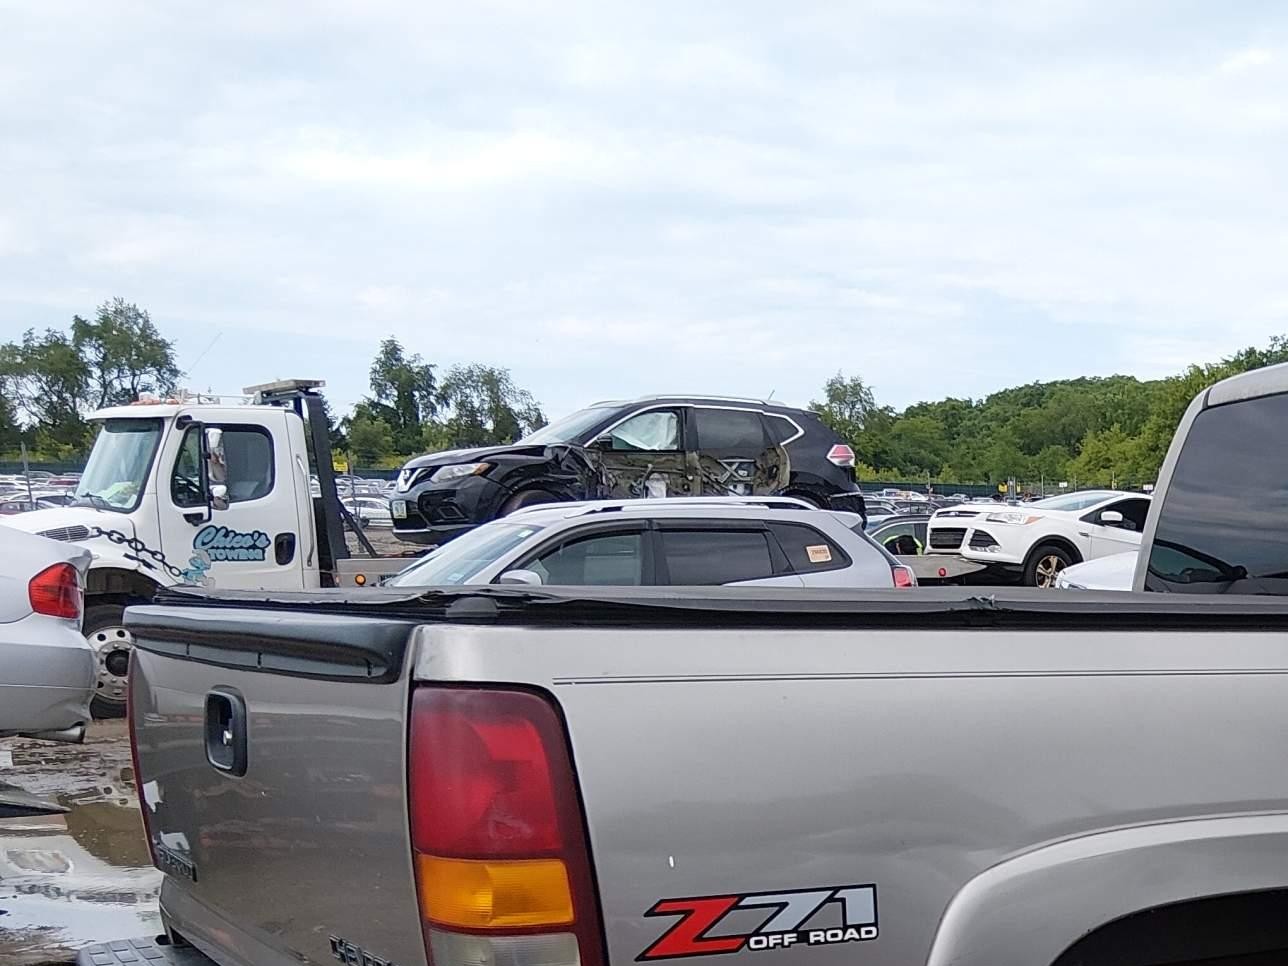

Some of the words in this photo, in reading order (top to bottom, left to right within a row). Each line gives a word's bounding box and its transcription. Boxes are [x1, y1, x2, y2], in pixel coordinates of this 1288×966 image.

[193, 525, 271, 551] Chico's
[634, 883, 879, 962] Z71
[747, 933, 799, 952] OFF
[807, 925, 879, 946] ROAD
